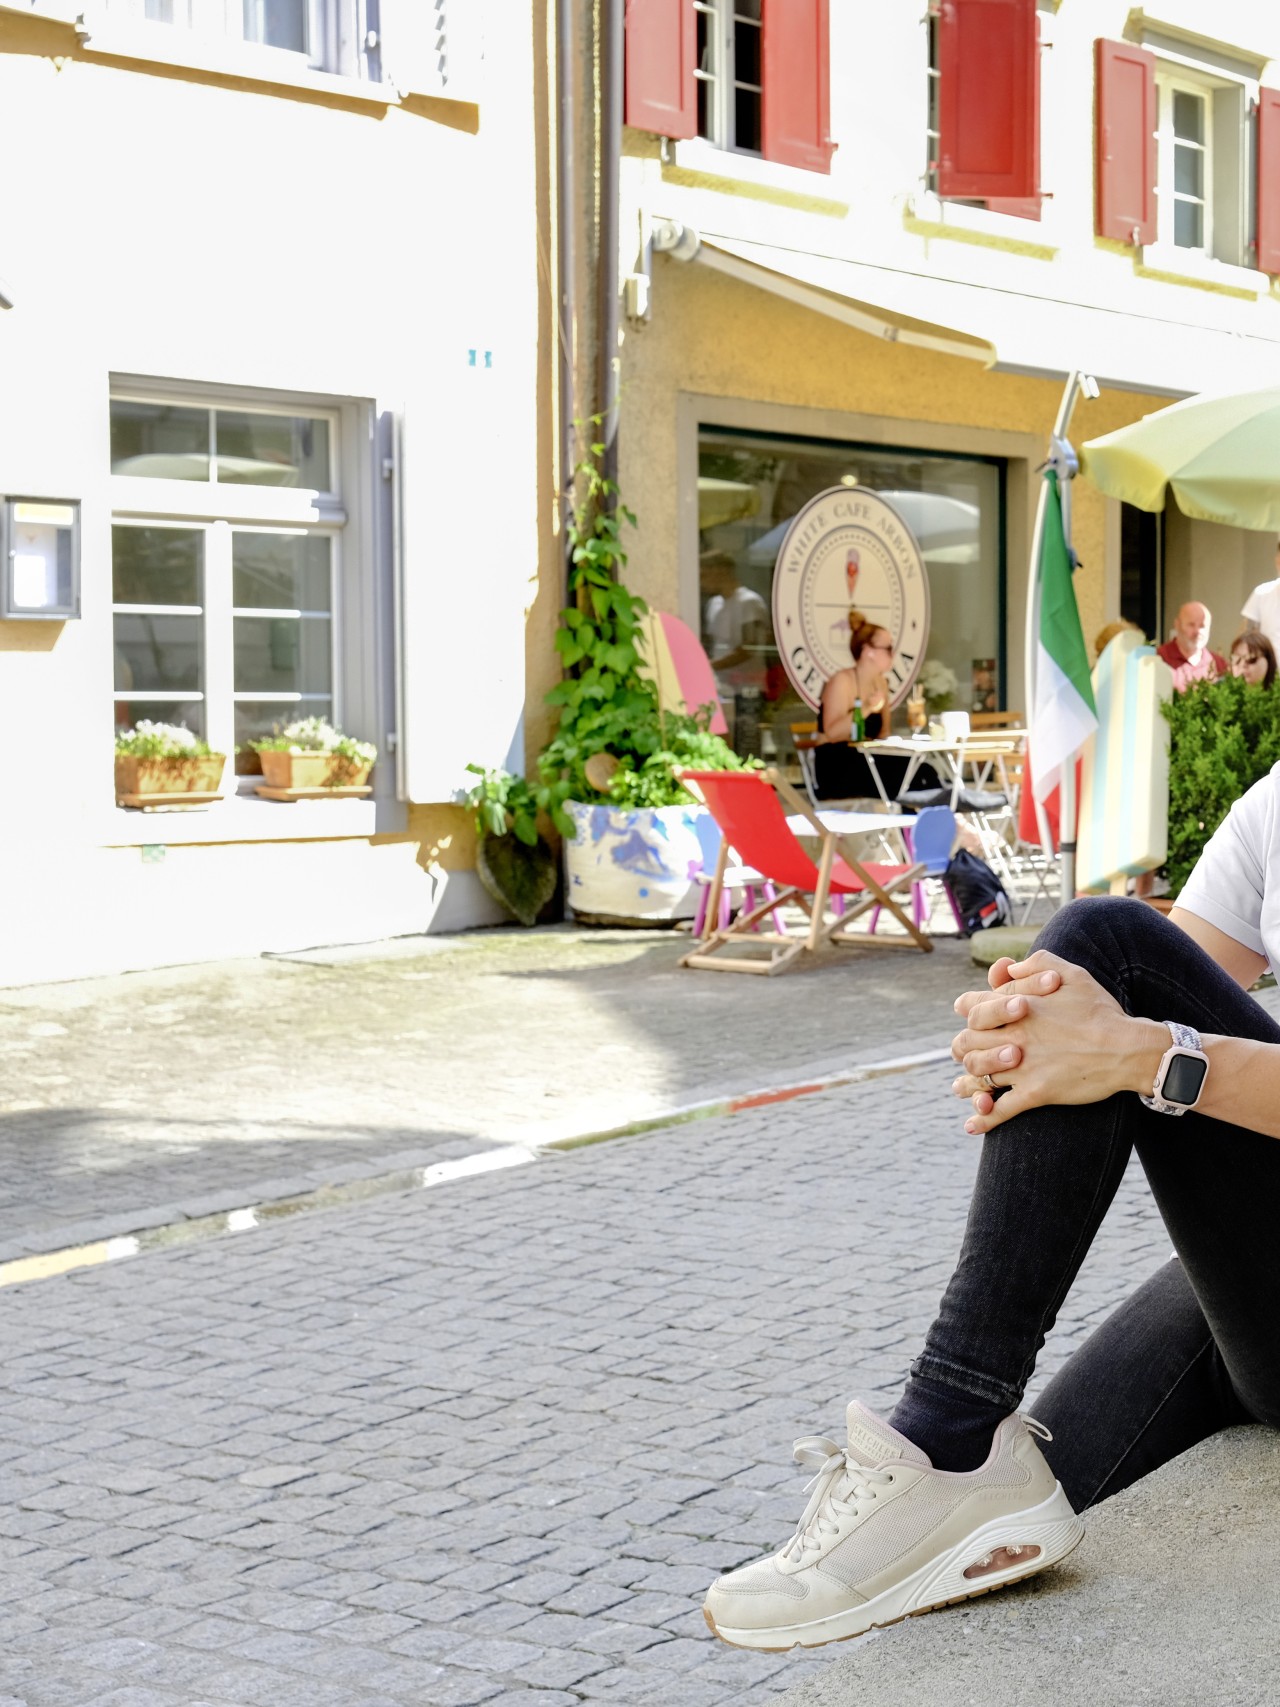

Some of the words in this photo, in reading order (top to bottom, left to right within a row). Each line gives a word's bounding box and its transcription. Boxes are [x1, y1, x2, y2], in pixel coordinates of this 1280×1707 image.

[787, 511, 828, 574] WHITE
[833, 502, 872, 520] CAFE
[877, 517, 917, 580] ARBON
